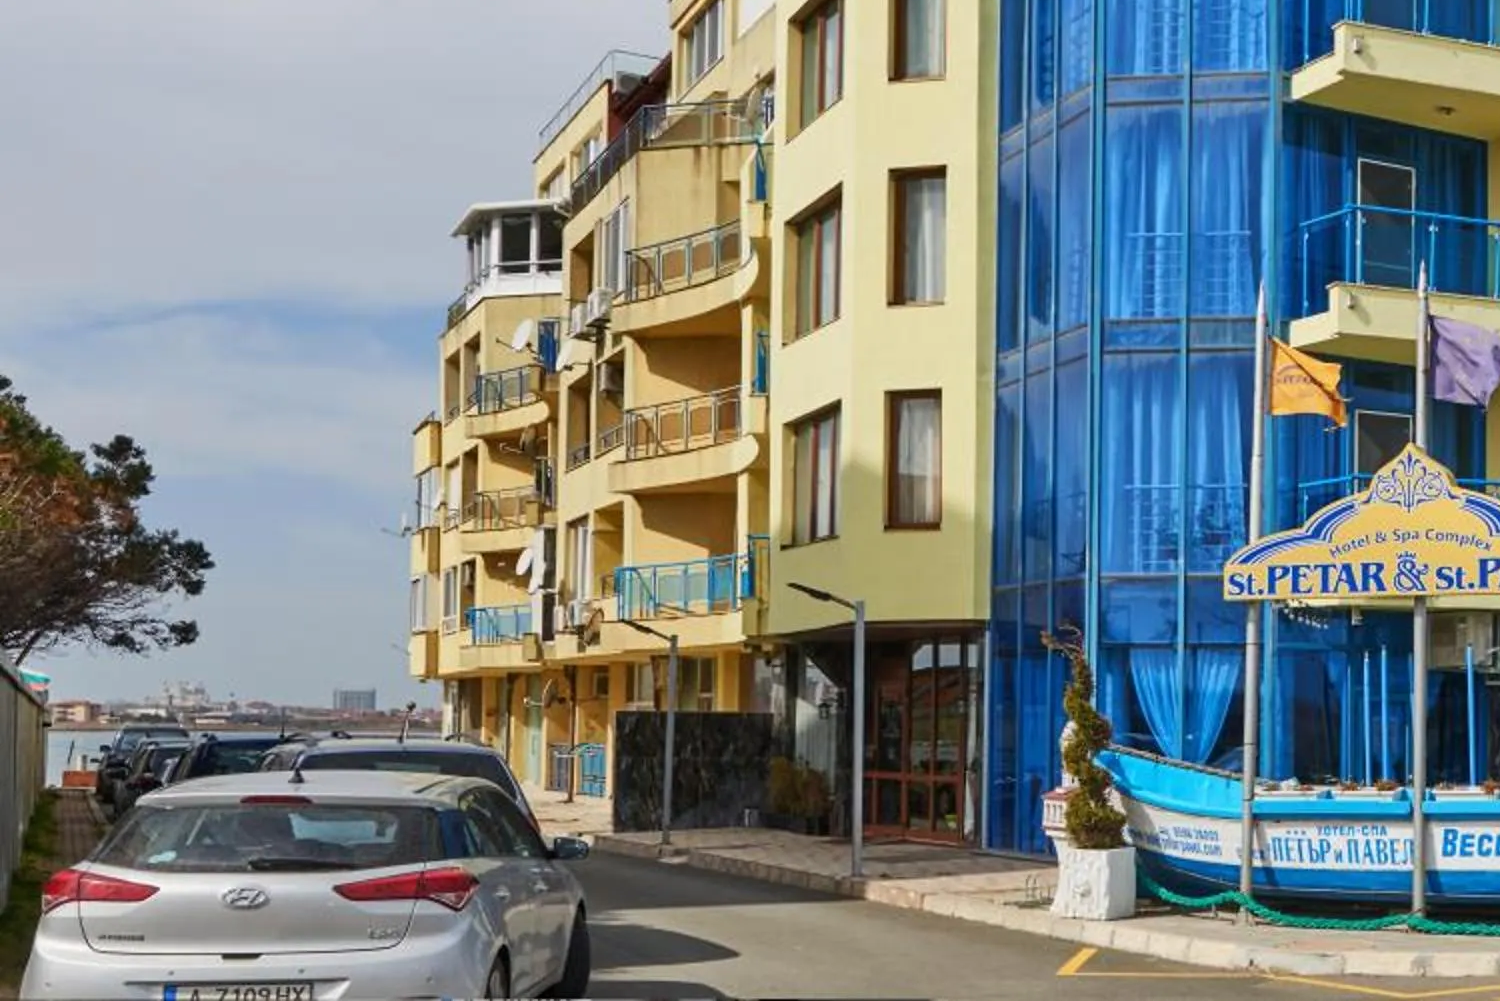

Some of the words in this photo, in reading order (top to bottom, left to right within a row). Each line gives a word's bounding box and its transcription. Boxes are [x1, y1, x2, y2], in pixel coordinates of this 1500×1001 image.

[1329, 534, 1371, 559] Hotel
[1375, 530, 1387, 544] &
[1392, 528, 1420, 544] Spa
[1425, 528, 1493, 552] Complex
[1393, 550, 1429, 593] &
[1347, 837, 1415, 865] ПАВЕЛ
